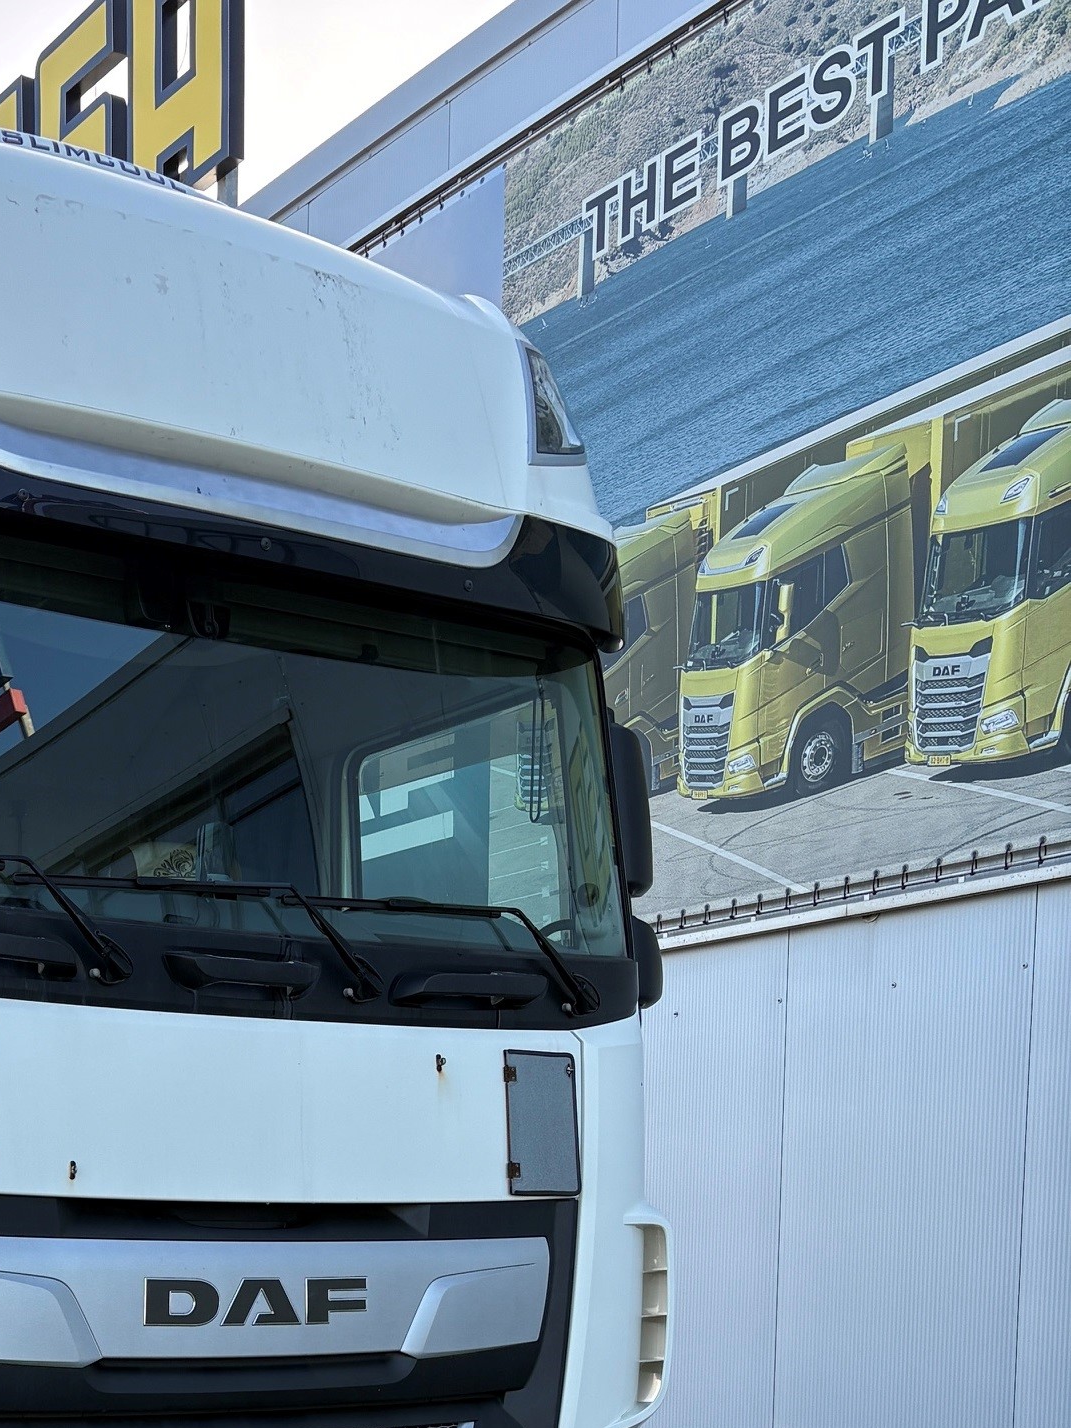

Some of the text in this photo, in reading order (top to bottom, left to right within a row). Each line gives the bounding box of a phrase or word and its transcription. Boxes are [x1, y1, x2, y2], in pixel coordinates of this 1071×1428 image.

[584, 145, 701, 256] THE
[720, 15, 903, 183] BEST
[932, 665, 961, 677] DAF
[694, 714, 714, 724] DAF
[143, 1277, 367, 1326] DAF
